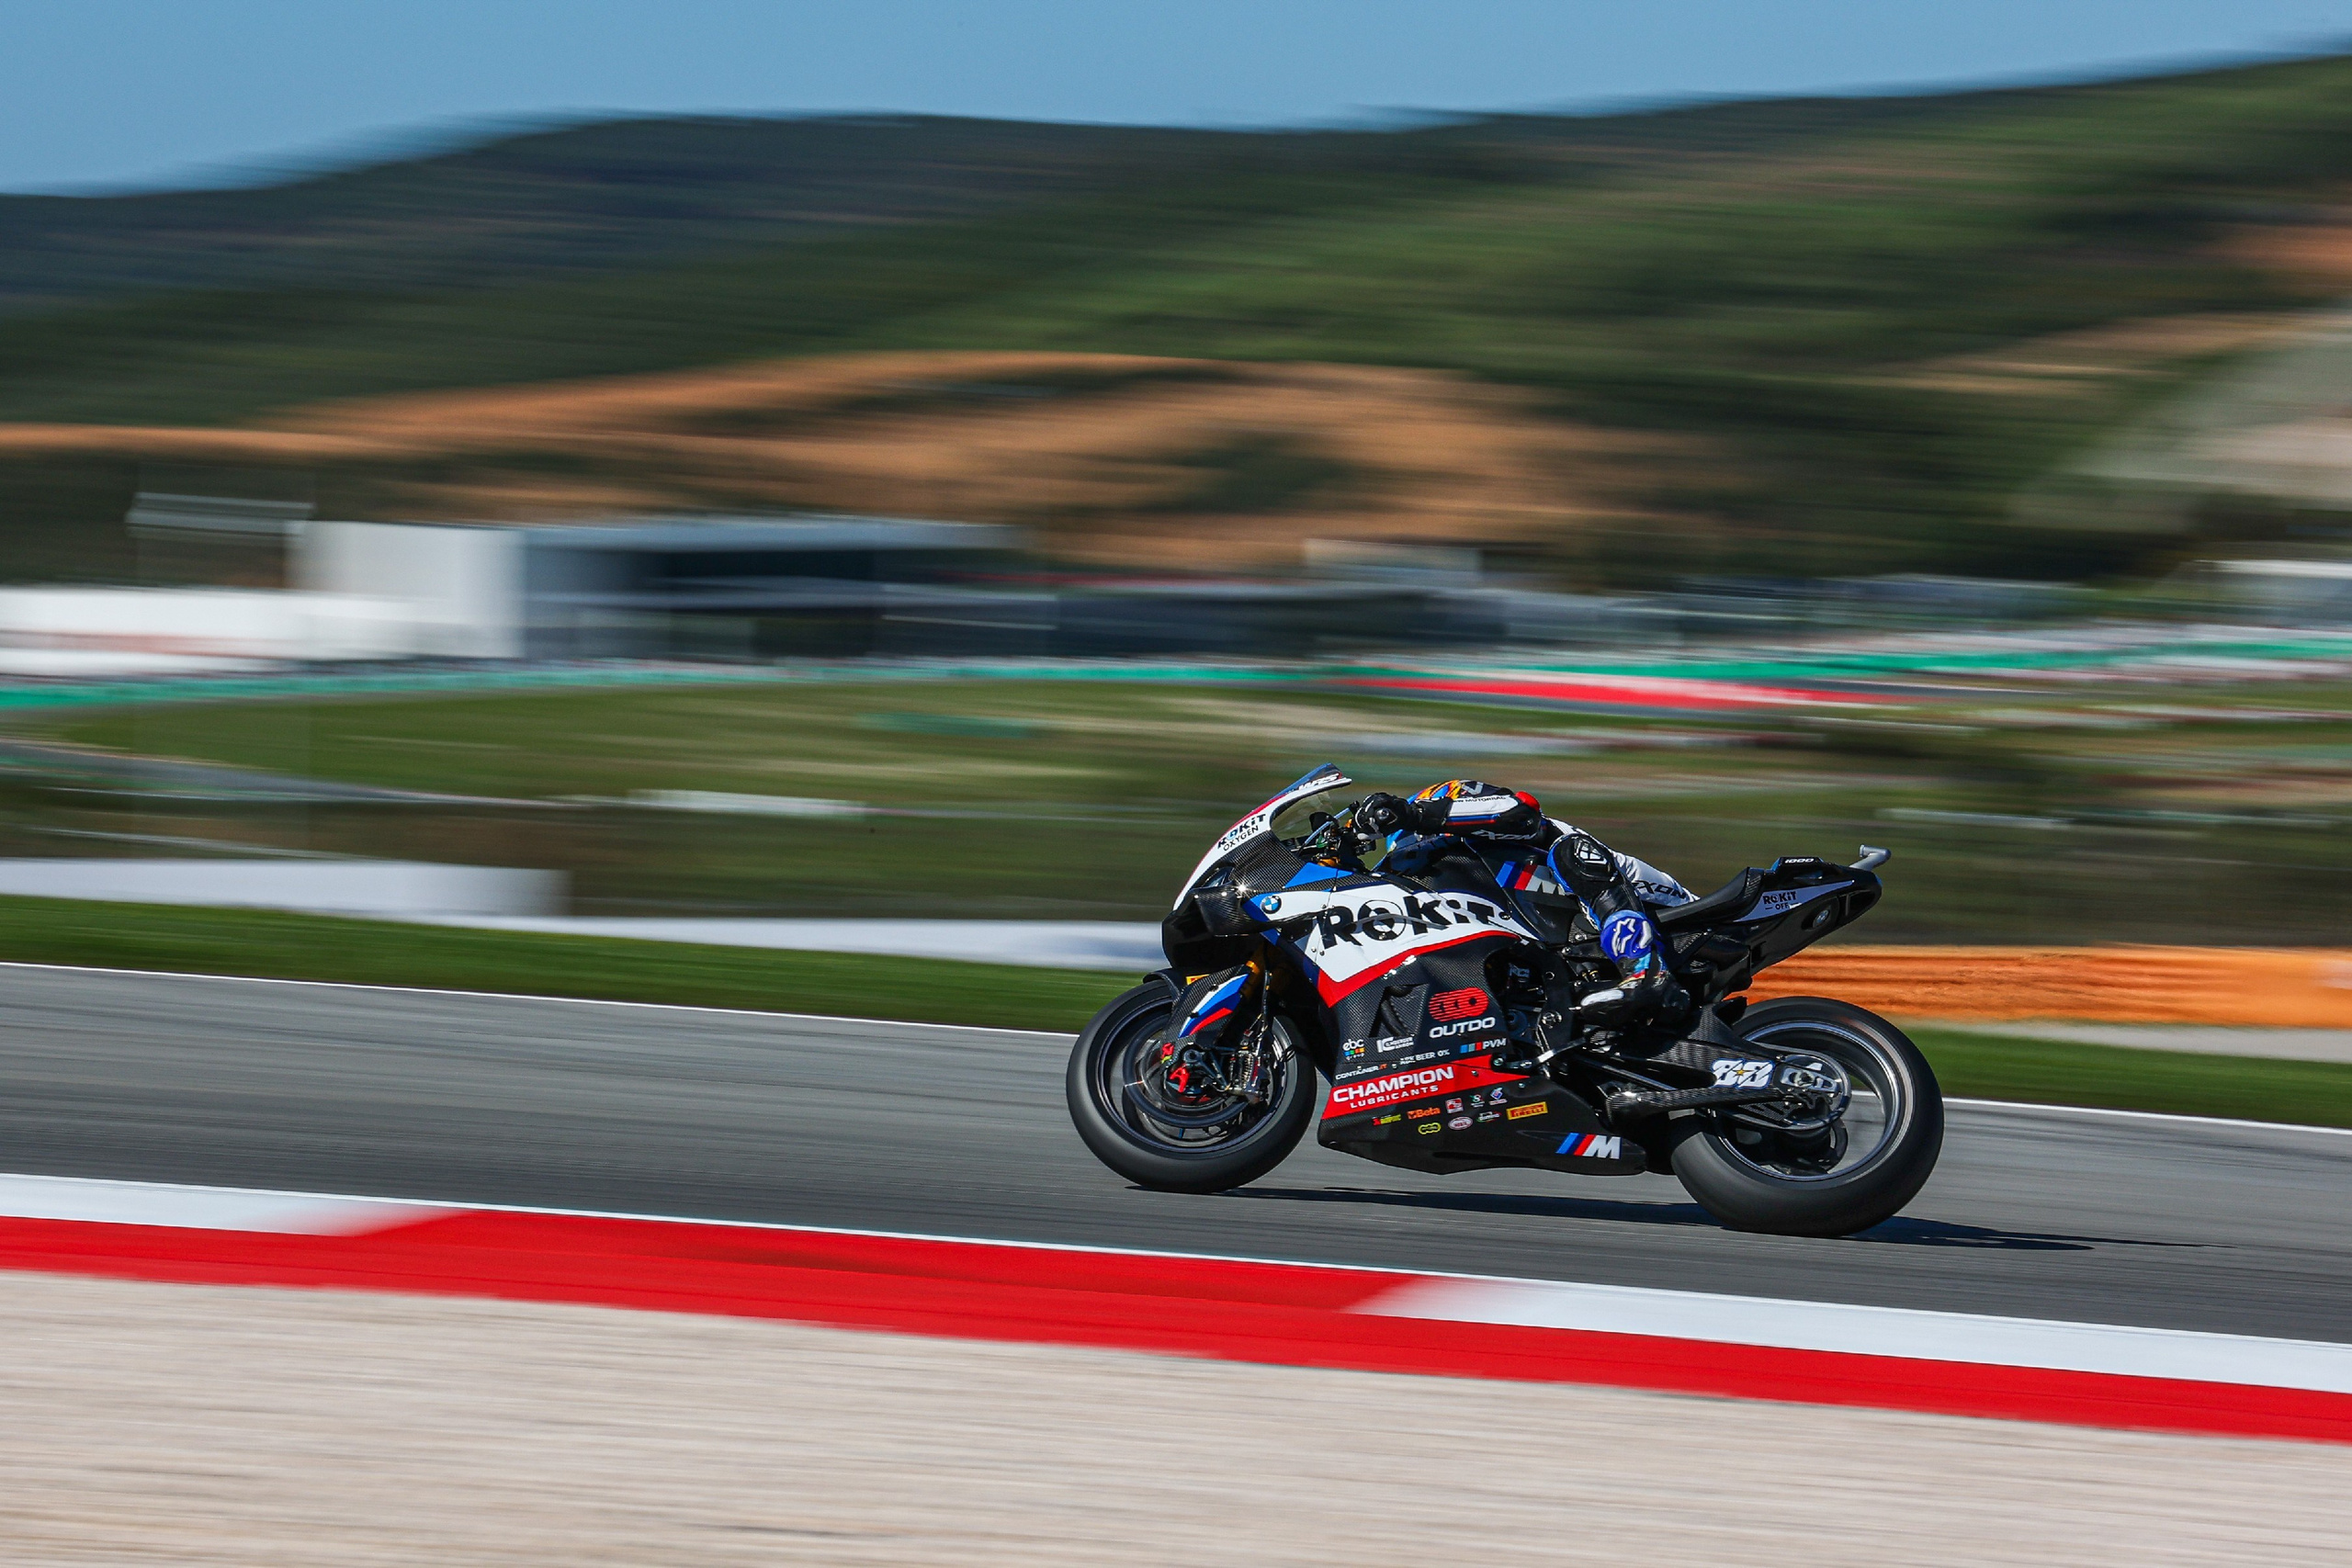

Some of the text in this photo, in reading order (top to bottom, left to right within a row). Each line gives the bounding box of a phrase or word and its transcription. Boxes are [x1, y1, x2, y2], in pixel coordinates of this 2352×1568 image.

[1223, 825, 1259, 852] OXYGEN
[1774, 902, 1789, 910] OFF
[1429, 1017, 1496, 1039] OUTDO
[1342, 1038, 1364, 1051] ebc
[1482, 1038, 1507, 1050] PVM
[1415, 1052, 1436, 1061] BEER
[1333, 1066, 1454, 1103] CHAMPION
[1350, 1085, 1440, 1109] LUBRICANTS
[1416, 1107, 1442, 1119] Beta
